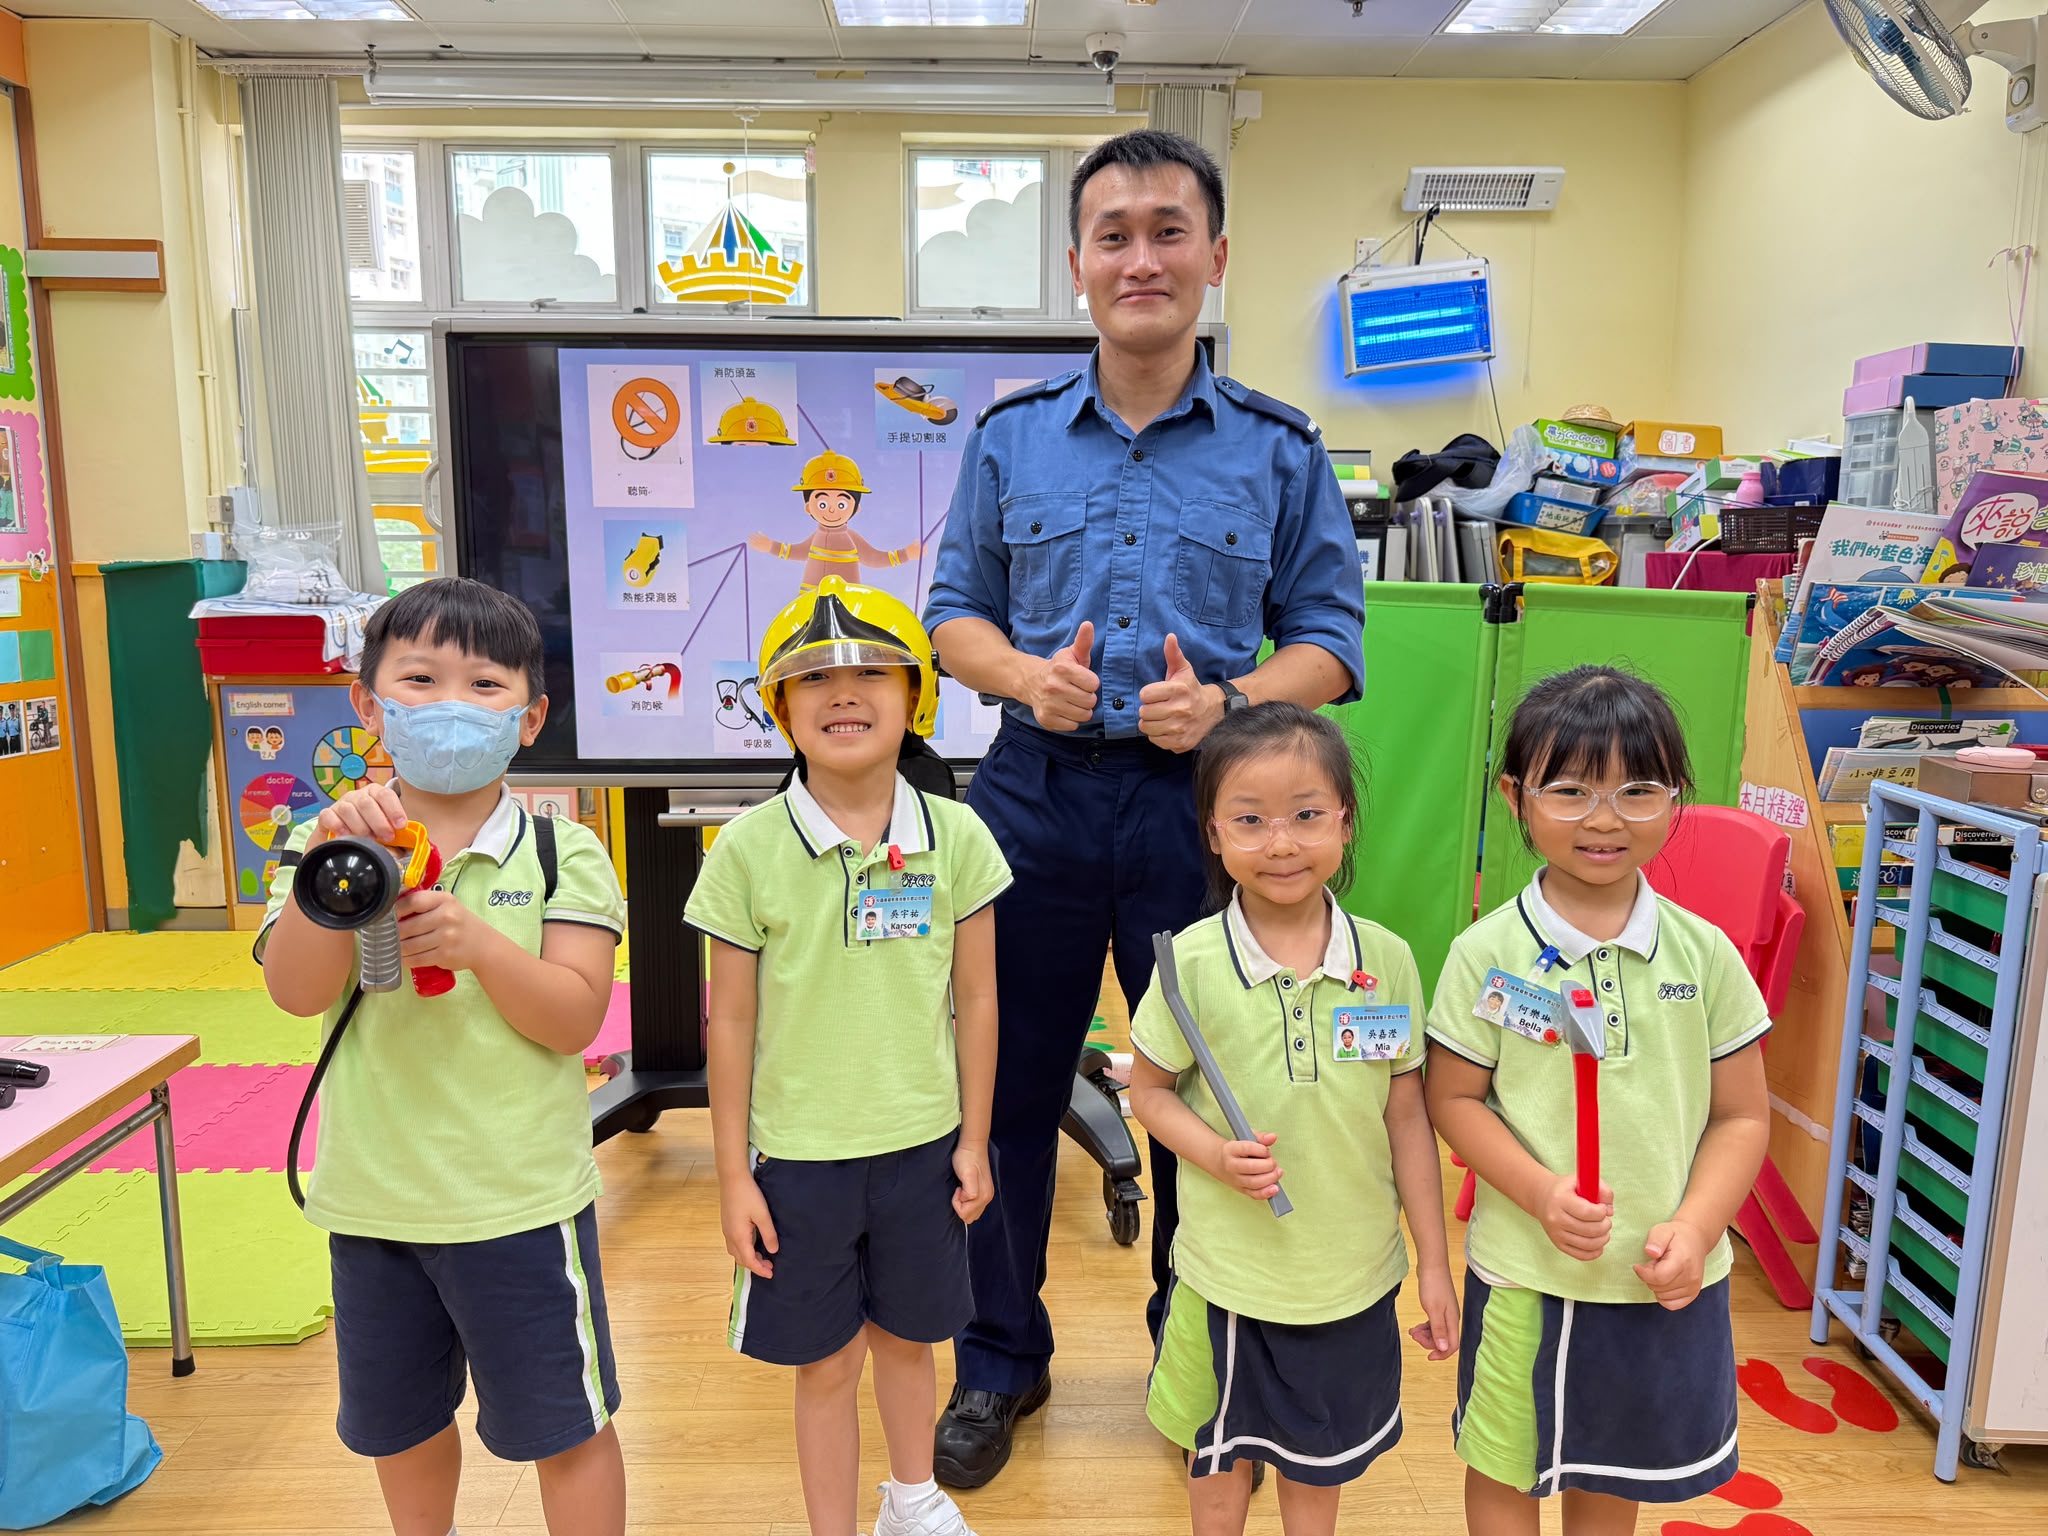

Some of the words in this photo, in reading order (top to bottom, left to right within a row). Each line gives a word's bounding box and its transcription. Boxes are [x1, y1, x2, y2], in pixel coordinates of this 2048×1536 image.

[714, 367, 756, 378] 消防頭盔
[887, 432, 947, 443] 手提切割器
[627, 486, 649, 496] 聽筒
[622, 592, 677, 603] 熱能探測器
[236, 701, 262, 710] English
[632, 701, 663, 711] 消防喉
[1911, 723, 1961, 731] Discoveries
[743, 739, 772, 748] 呼吸器
[266, 776, 295, 785] doctor
[1741, 782, 1805, 826] 本月精選
[890, 922, 917, 930] Karson
[1519, 1018, 1542, 1033] Bella
[1375, 1043, 1391, 1051] Mia
